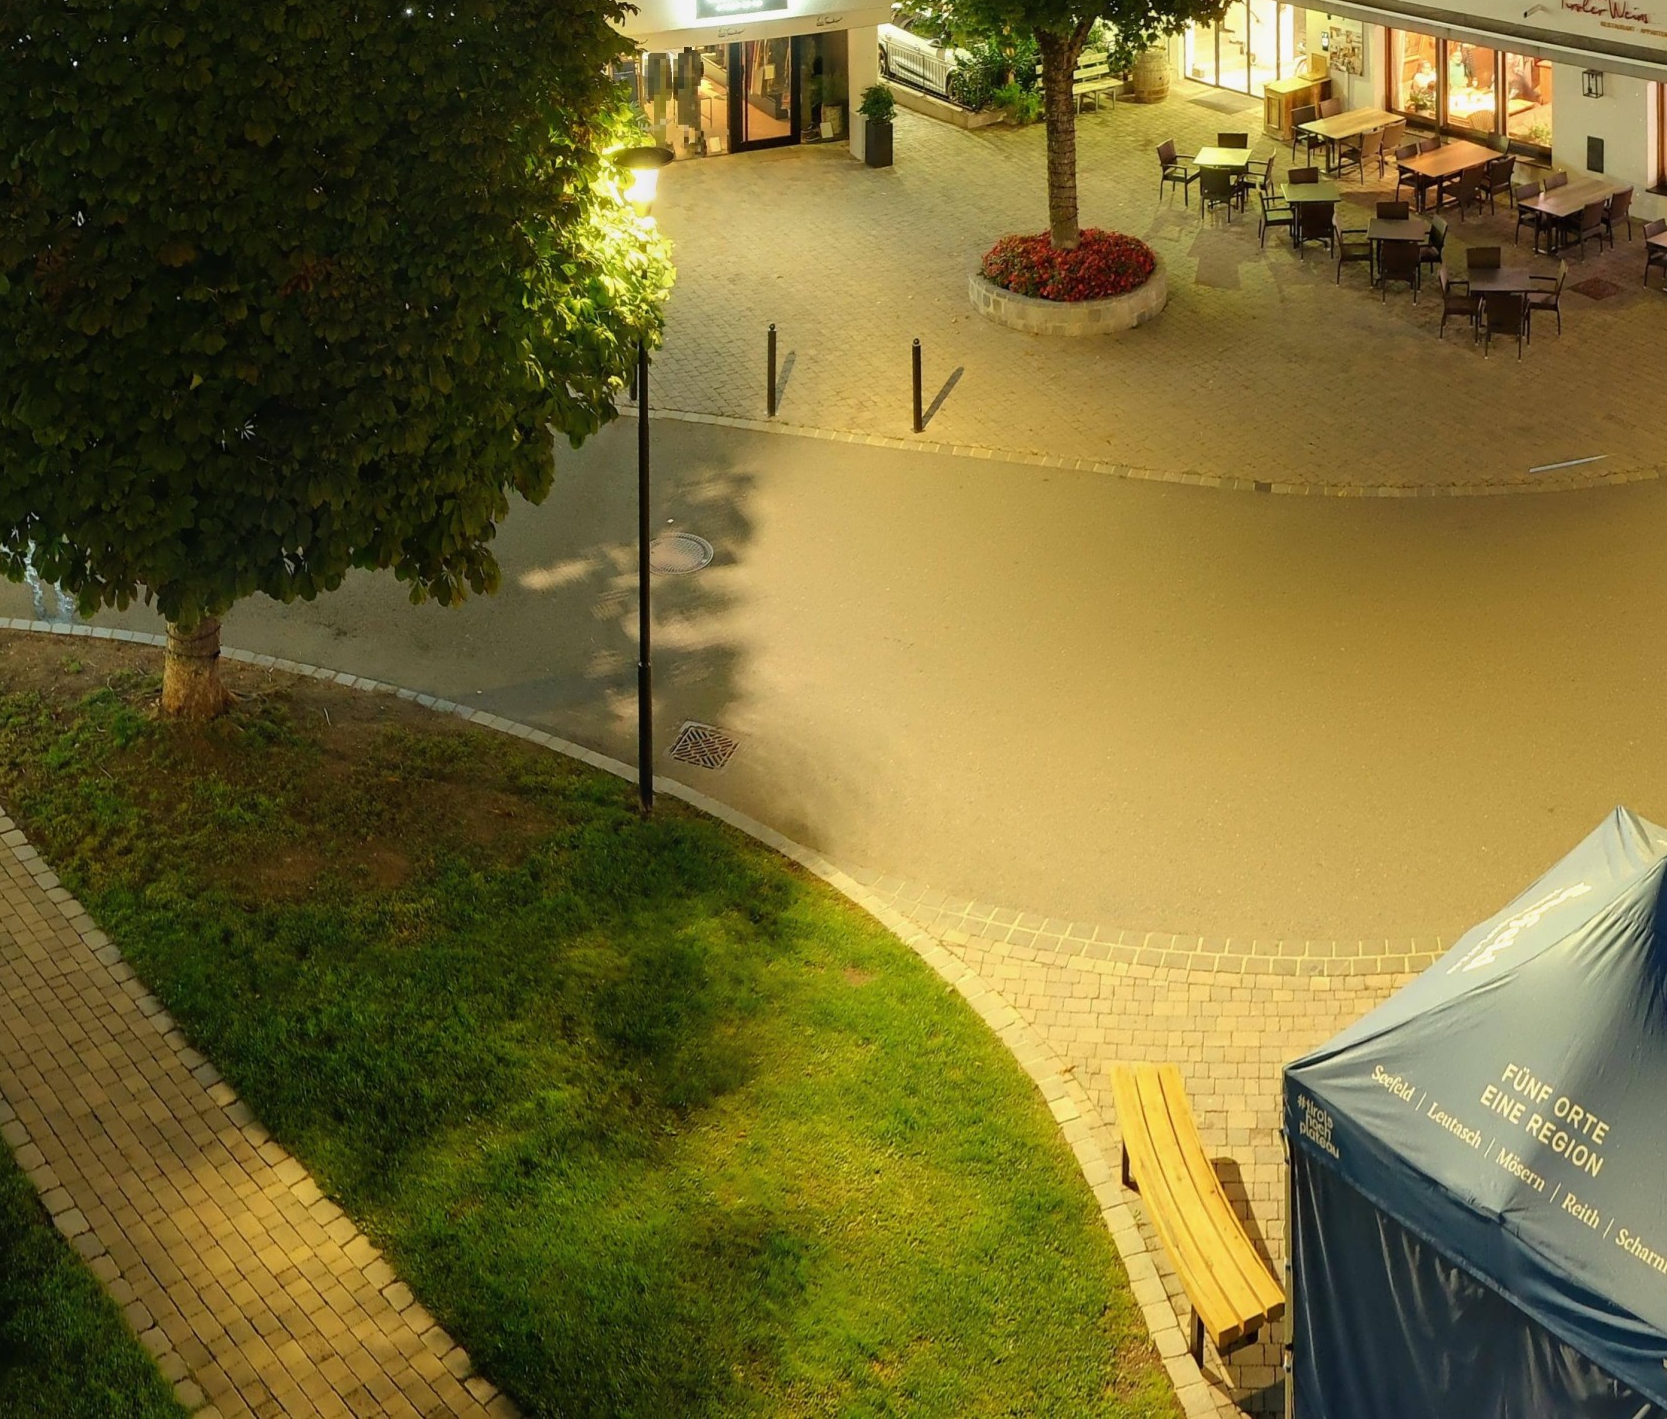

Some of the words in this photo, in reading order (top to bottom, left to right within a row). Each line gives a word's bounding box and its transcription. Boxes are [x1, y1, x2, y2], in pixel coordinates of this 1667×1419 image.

[1297, 1095, 1334, 1129] #tirols
[1305, 1112, 1331, 1141] hoch
[1480, 1086, 1526, 1124] EINE
[1525, 1117, 1605, 1177] REGION
[1501, 1062, 1553, 1105] FÜNF
[1554, 1096, 1611, 1145] ORTE
[1299, 1122, 1340, 1160] plateau
[1371, 1064, 1415, 1103] Seefeld
[1427, 1101, 1483, 1149] Leutasch
[1495, 1146, 1546, 1193] Mösern
[1561, 1192, 1601, 1230] Reith
